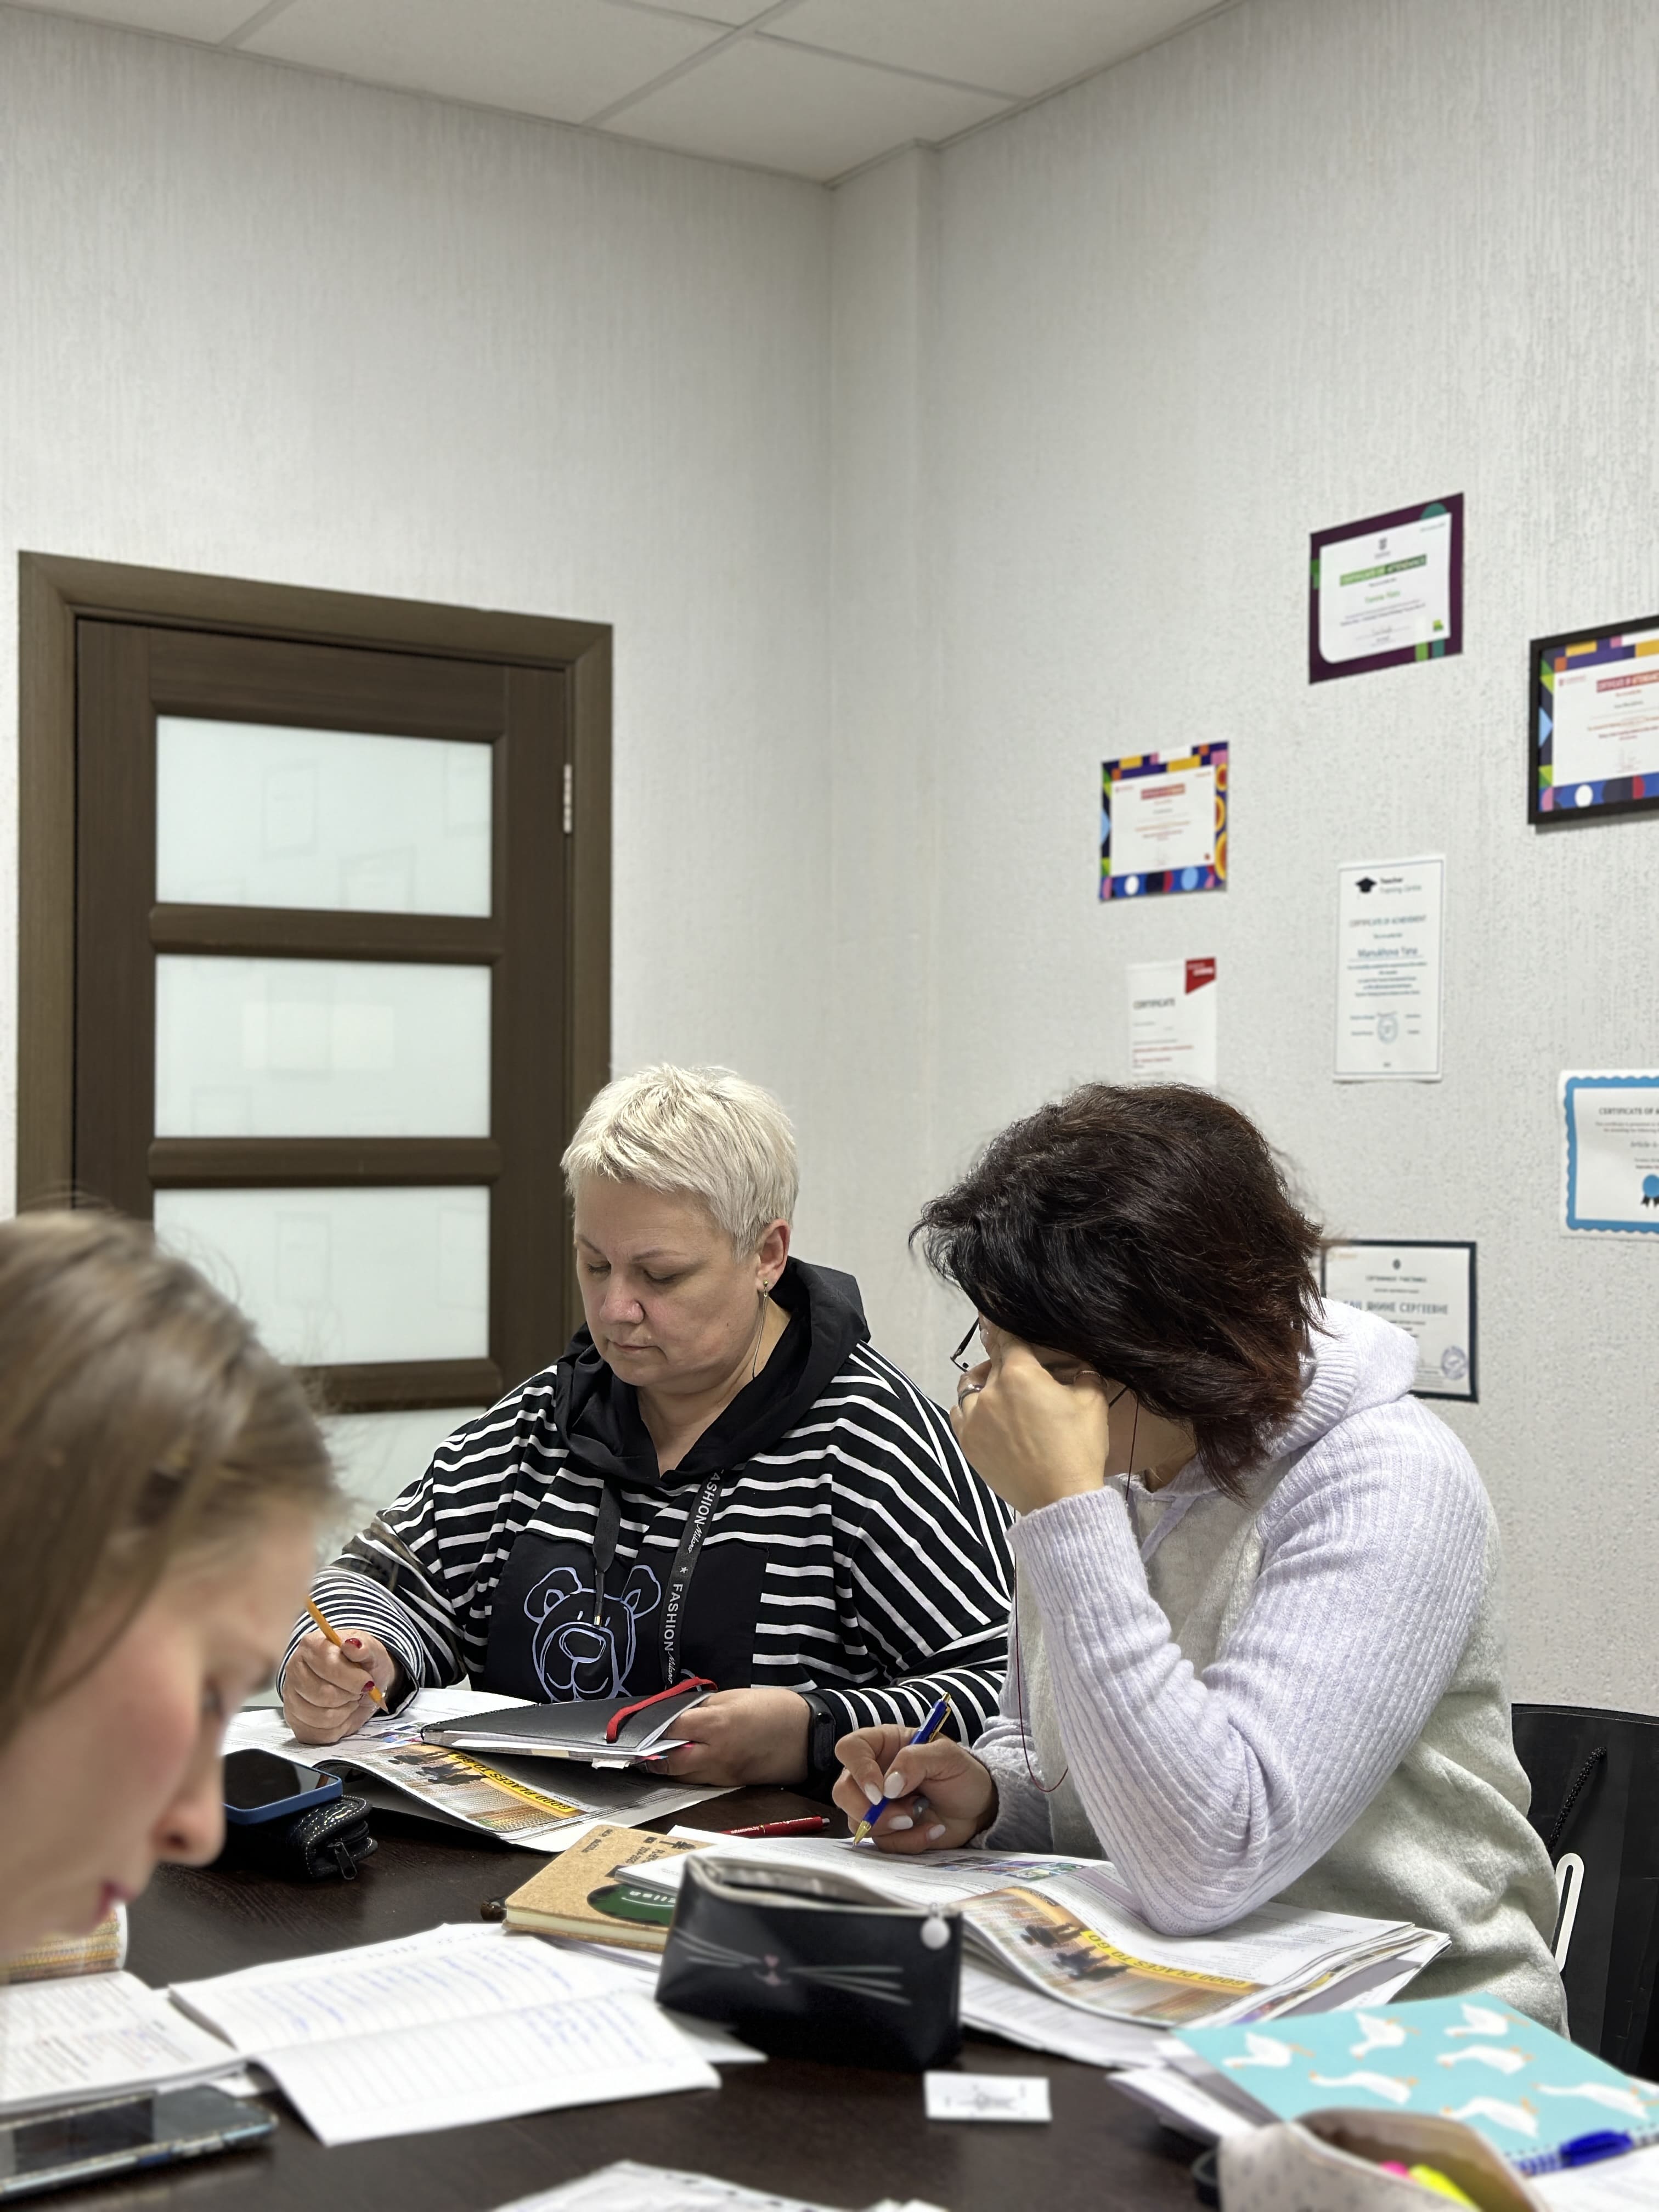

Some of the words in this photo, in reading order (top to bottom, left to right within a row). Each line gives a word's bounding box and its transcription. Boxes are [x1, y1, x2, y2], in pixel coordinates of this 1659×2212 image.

[687, 1523, 704, 1554] Milano
[663, 1583, 684, 1651] FASHION
[665, 1650, 677, 1684] Milano
[455, 1754, 475, 1764] GO
[474, 1764, 490, 1773] TO
[489, 1773, 538, 1796] PLACES
[535, 1795, 571, 1810] GOOD
[1088, 1934, 1111, 1949] GO
[1111, 1950, 1133, 1962] TO
[1133, 1961, 1197, 1978] PLACES
[1199, 1974, 1246, 1986] GOOD
